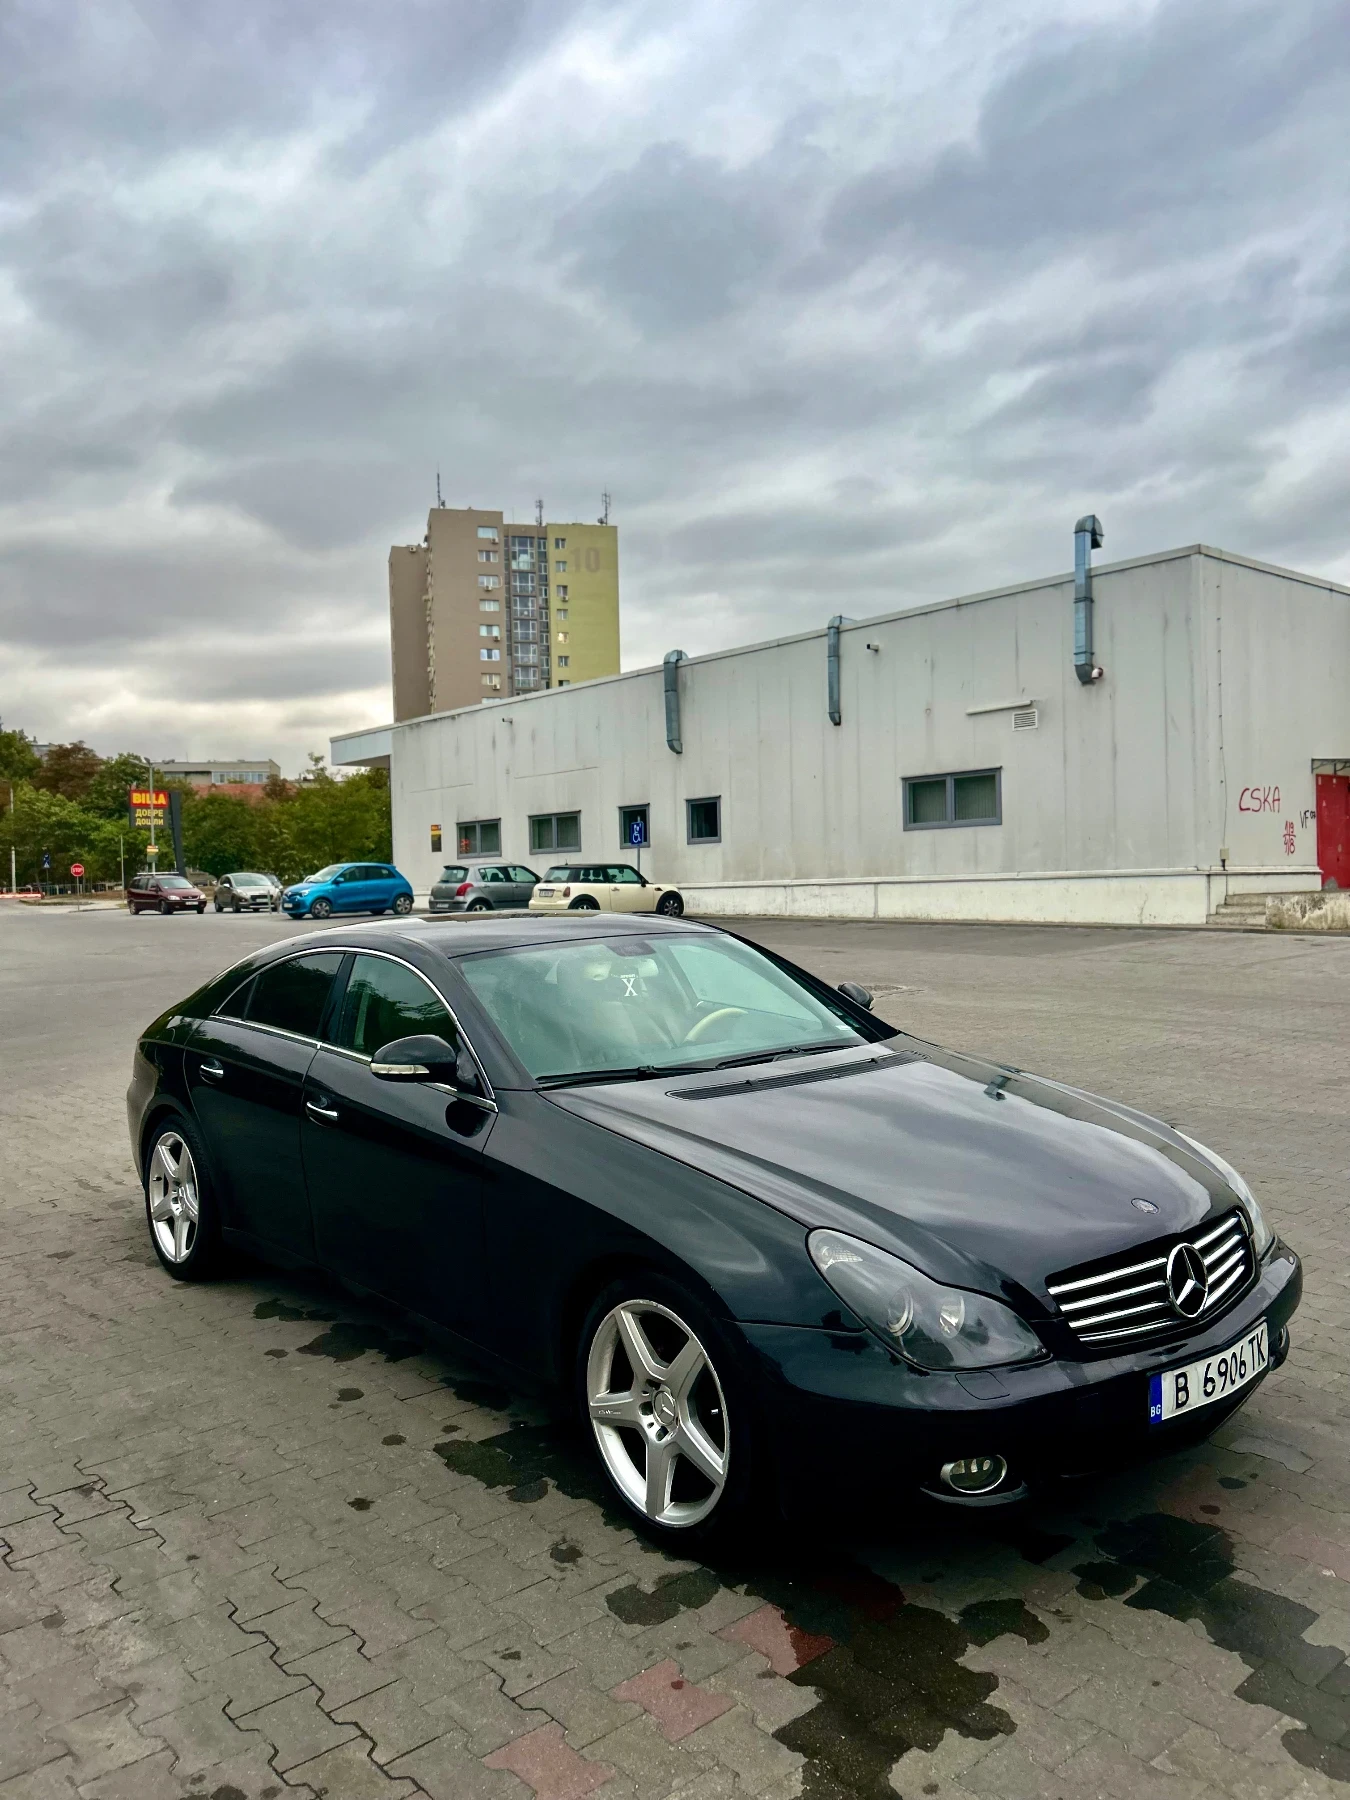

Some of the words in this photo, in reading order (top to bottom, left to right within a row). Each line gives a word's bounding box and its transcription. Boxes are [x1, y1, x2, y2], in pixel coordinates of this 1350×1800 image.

[571, 547, 600, 572] 10
[132, 793, 166, 804] BILLA
[1238, 785, 1281, 813] CSKA
[1175, 1372, 1190, 1409] B
[1150, 1404, 1161, 1417] BG
